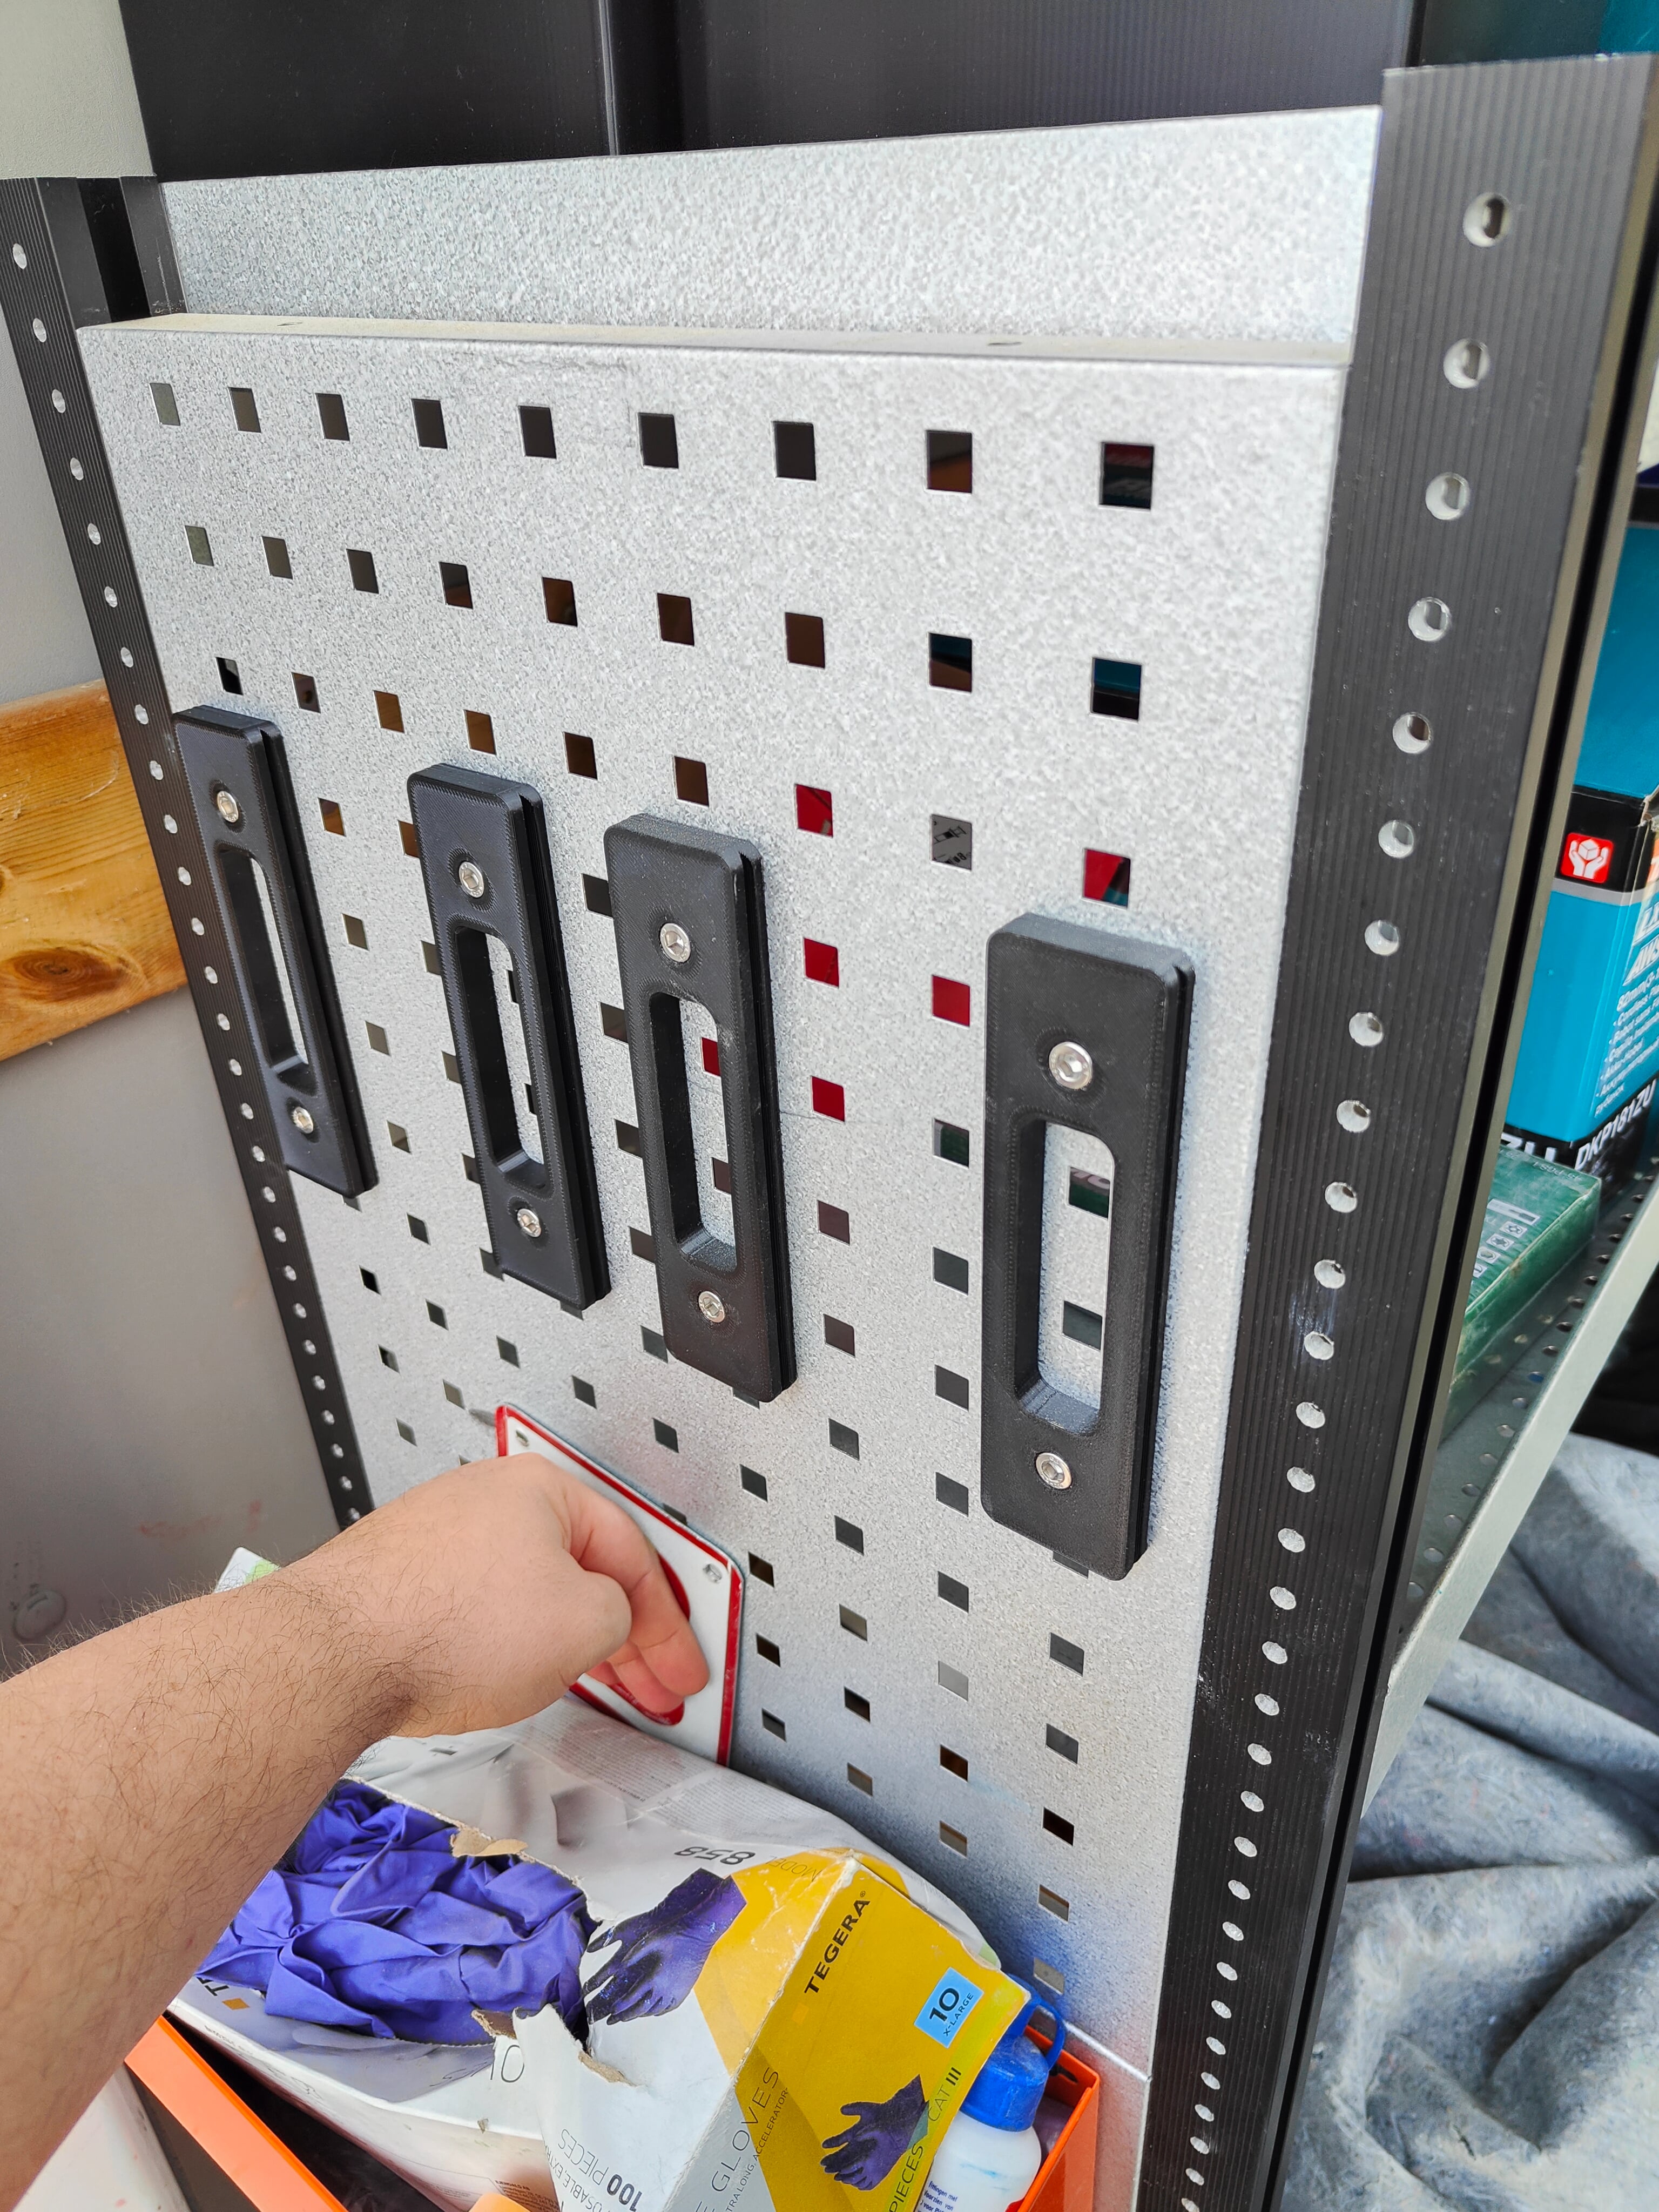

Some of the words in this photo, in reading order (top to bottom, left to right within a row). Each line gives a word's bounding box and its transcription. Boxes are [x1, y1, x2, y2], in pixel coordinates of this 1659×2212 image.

[1575, 1078, 1656, 1172] DKP181ZU
[674, 1846, 756, 1865] 858
[766, 1856, 822, 1883] MODEL
[929, 1987, 960, 2024] 10
[943, 1992, 974, 2037] X-LARGE
[927, 2085, 950, 2122] CAT
[711, 2067, 779, 2192] GLOVES
[558, 2128, 609, 2186] PIECES
[888, 2143, 924, 2212] PIECES
[606, 2174, 642, 2212] 100
